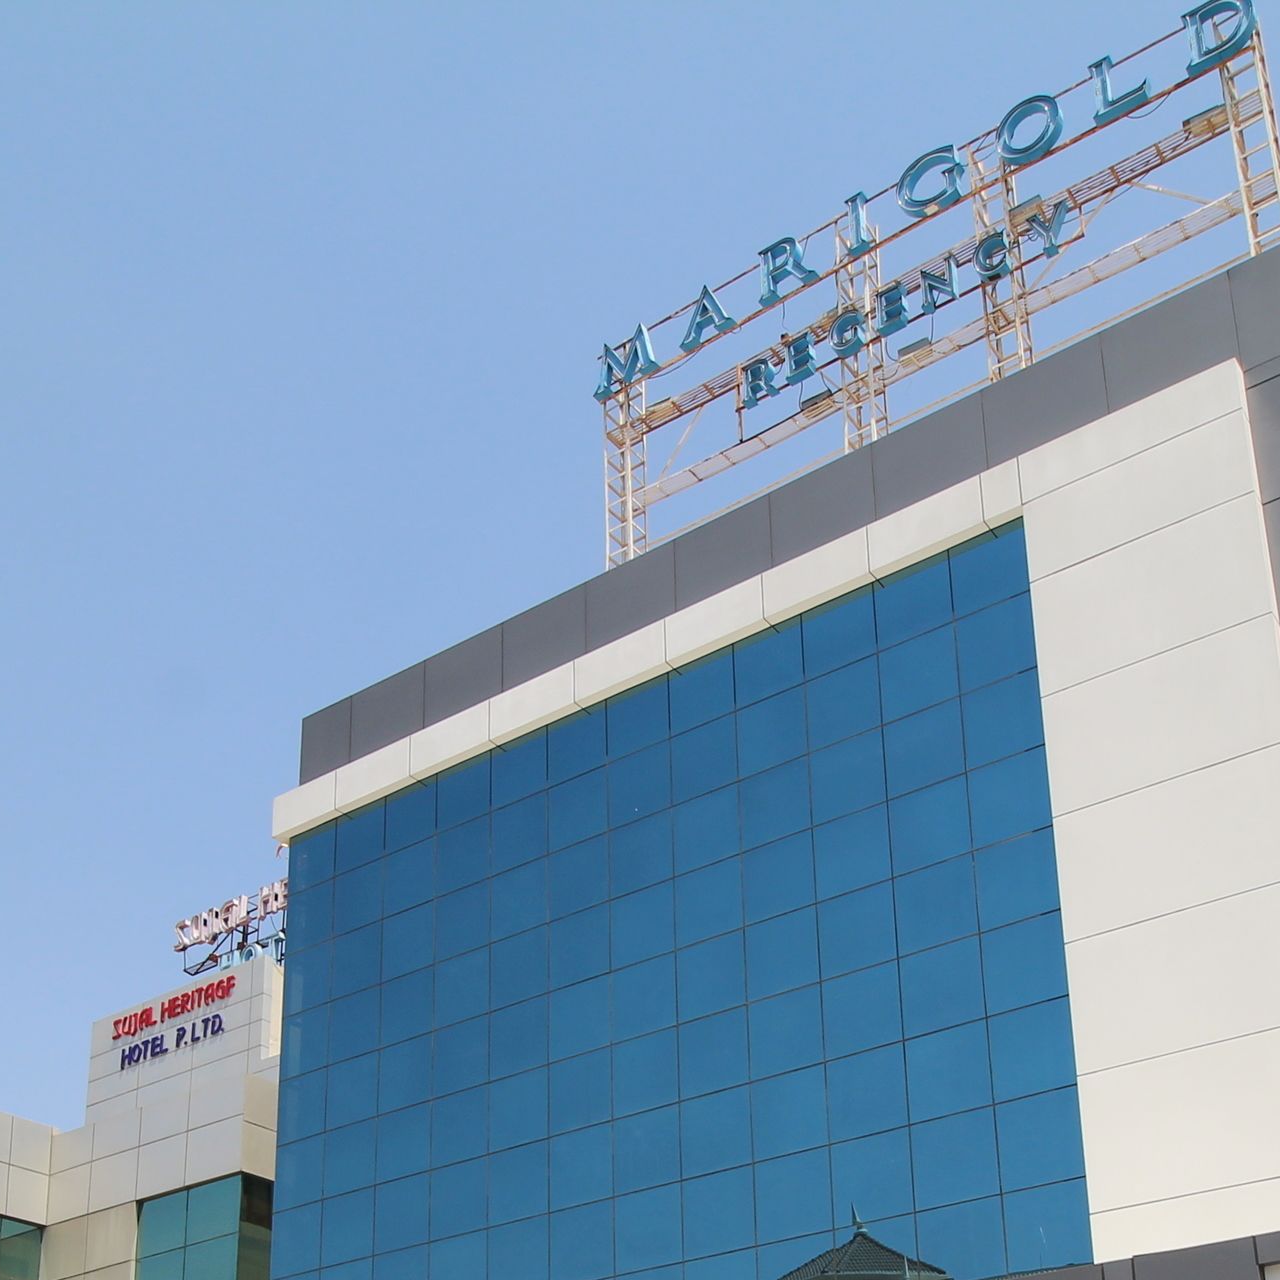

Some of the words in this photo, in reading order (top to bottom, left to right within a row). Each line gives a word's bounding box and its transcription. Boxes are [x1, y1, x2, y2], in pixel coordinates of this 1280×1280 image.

[593, 0, 1256, 401] MARIGOLD
[741, 199, 1070, 410] REGENCY
[112, 1006, 157, 1040] SUJAL
[120, 1034, 169, 1071] HOTEL
